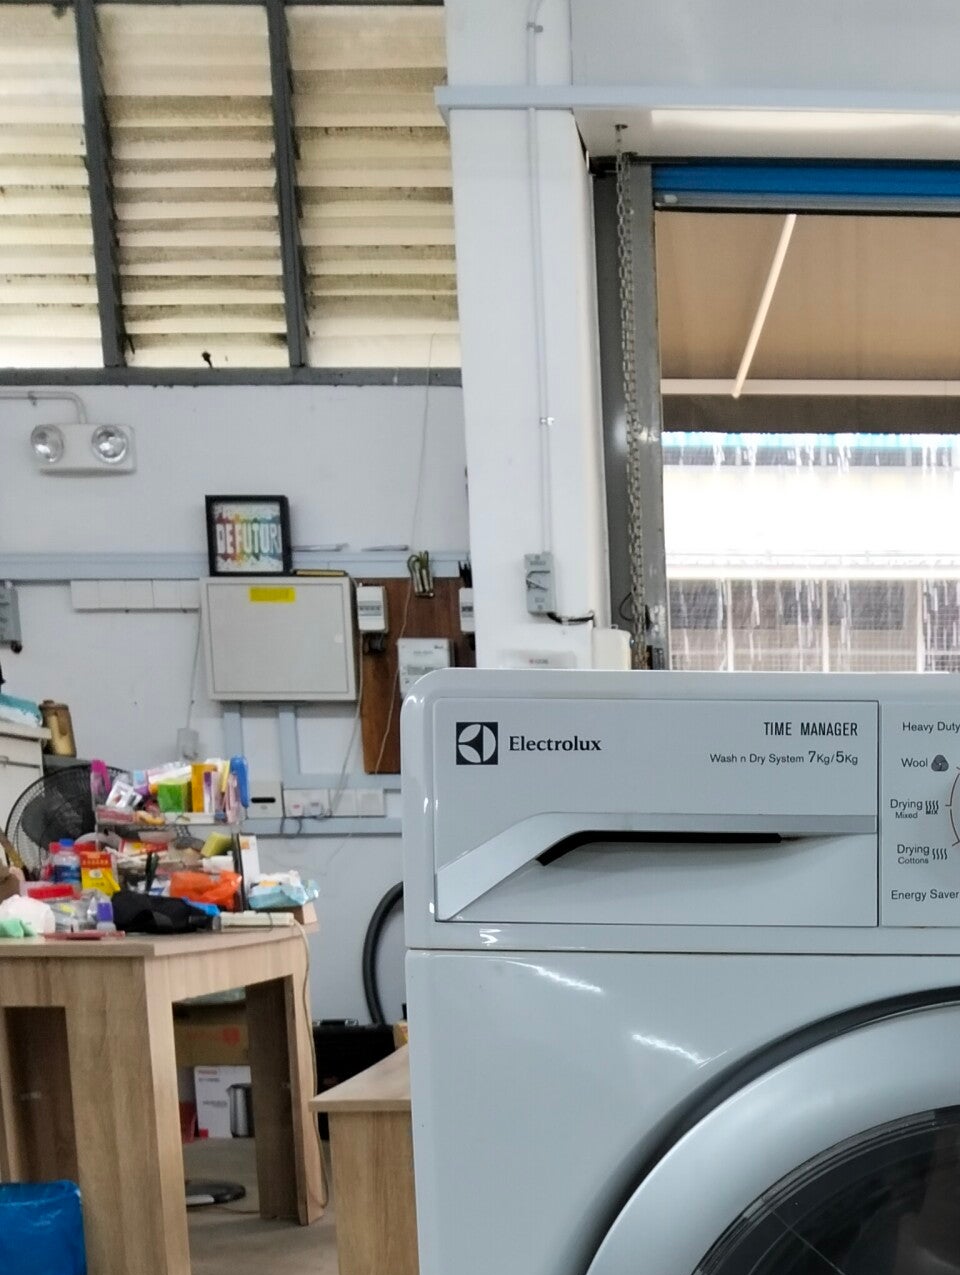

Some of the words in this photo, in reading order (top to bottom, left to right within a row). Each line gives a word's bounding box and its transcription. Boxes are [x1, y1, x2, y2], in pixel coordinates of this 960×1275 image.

[764, 722, 792, 736] TIME
[800, 722, 858, 736] MANAGER
[902, 722, 934, 733] Heavy
[937, 721, 960, 733] Duty
[509, 736, 602, 751] Electrolux
[710, 754, 737, 764] Wash
[749, 754, 766, 767] Dry
[768, 754, 804, 767] System
[901, 758, 928, 768] Wool
[890, 799, 923, 810] Drying
[895, 811, 918, 819] Mixed
[897, 844, 930, 856] Drying
[898, 857, 929, 865] Cottons
[891, 890, 927, 901] Energy
[930, 889, 959, 900] Saver
